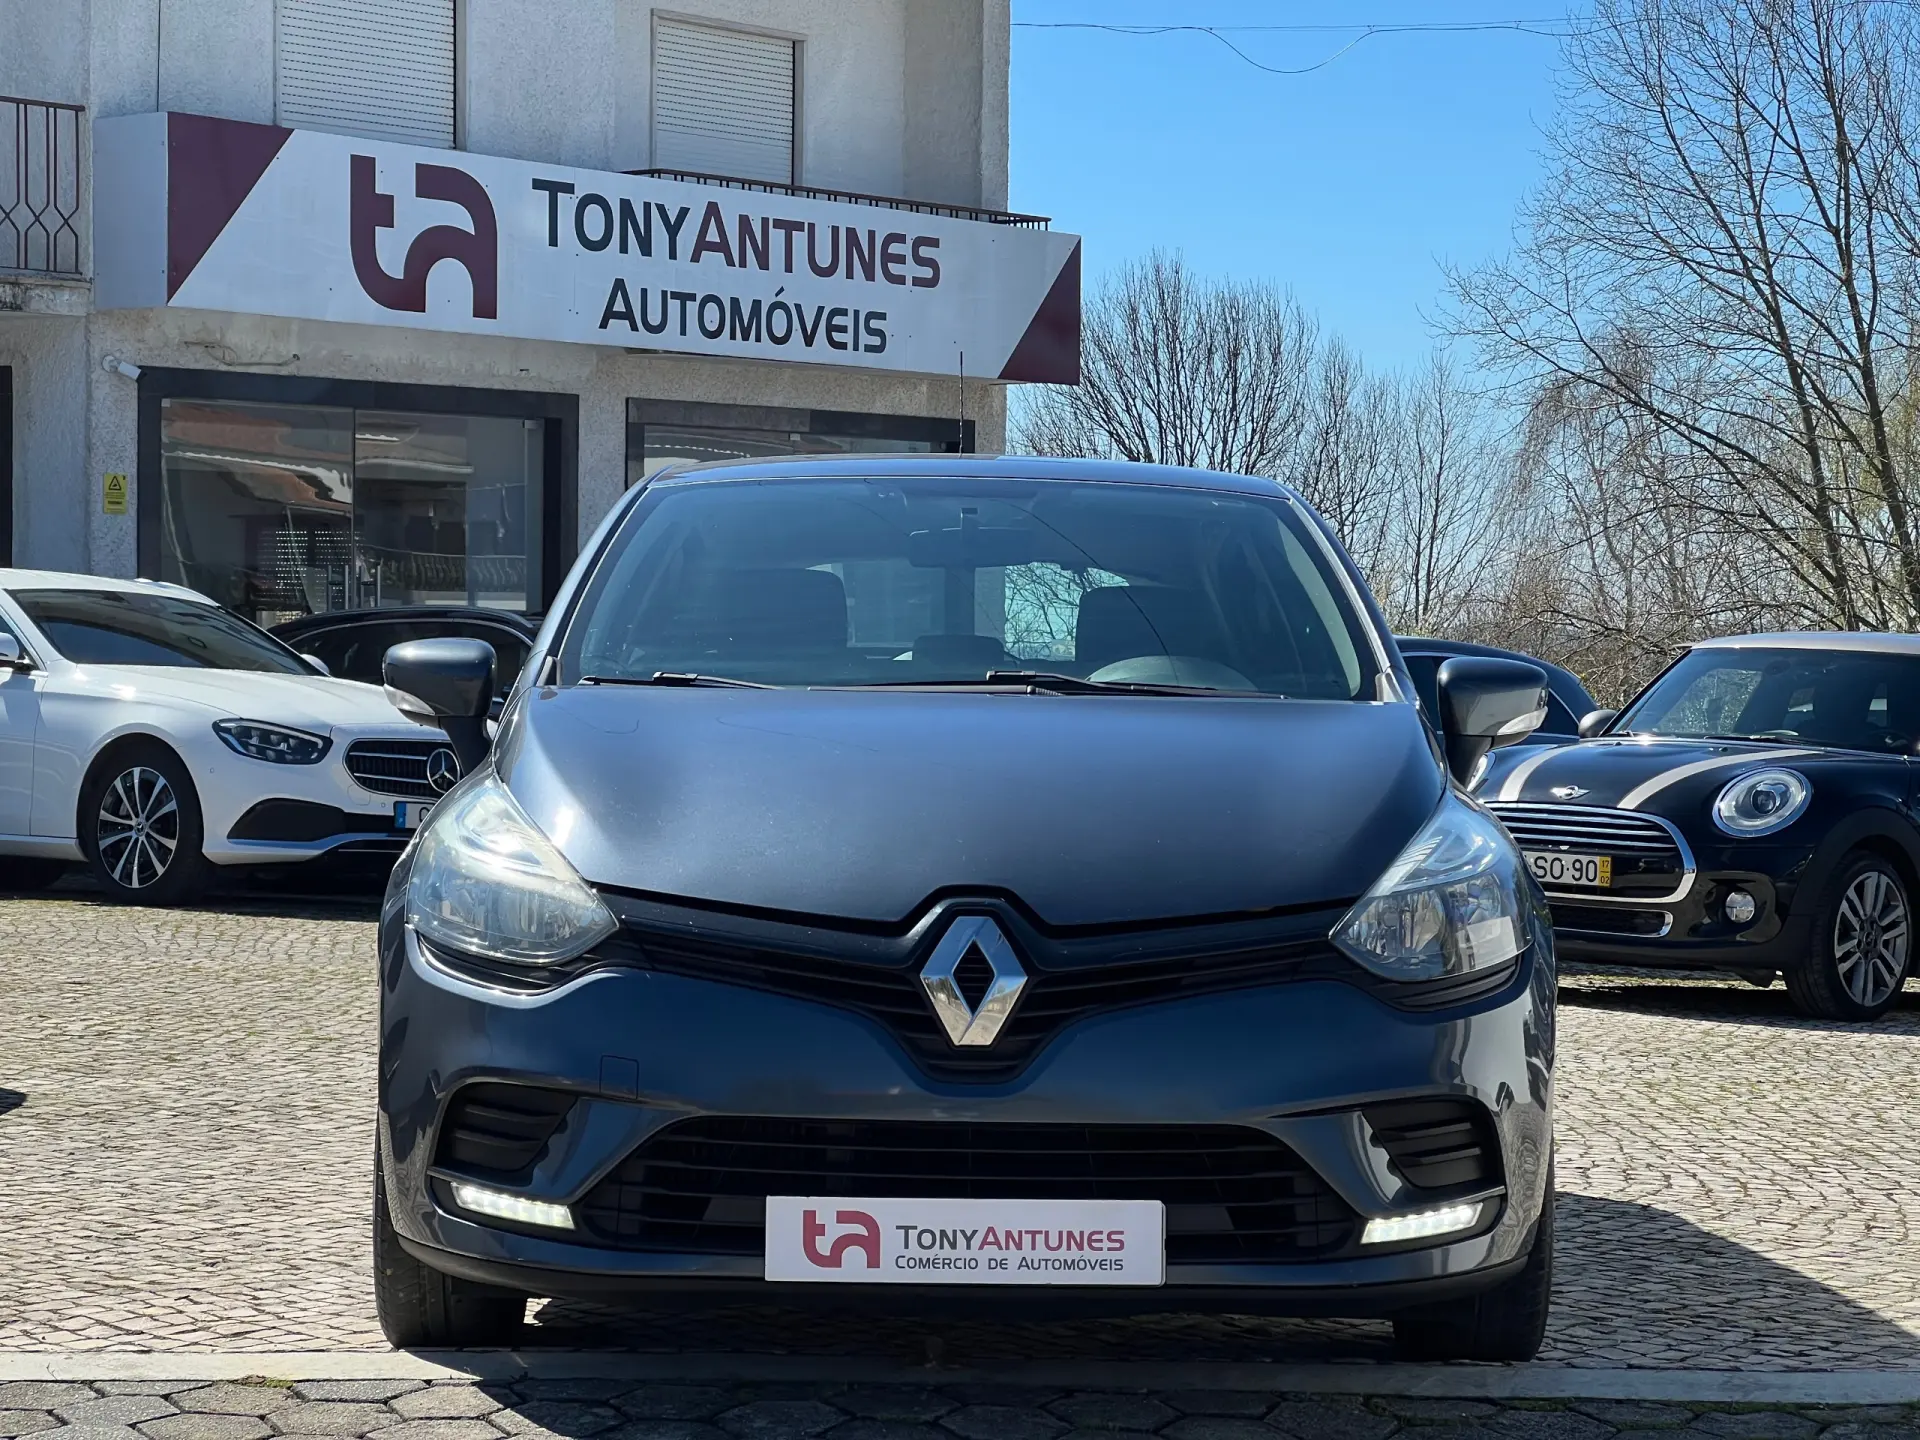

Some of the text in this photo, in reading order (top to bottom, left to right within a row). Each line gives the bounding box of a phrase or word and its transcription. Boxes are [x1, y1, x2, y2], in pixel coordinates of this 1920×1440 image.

[598, 278, 887, 354] AUTOMÓVEIS
[895, 1254, 1124, 1271] COMÉRCIO DE AUTOMÓVEIS
